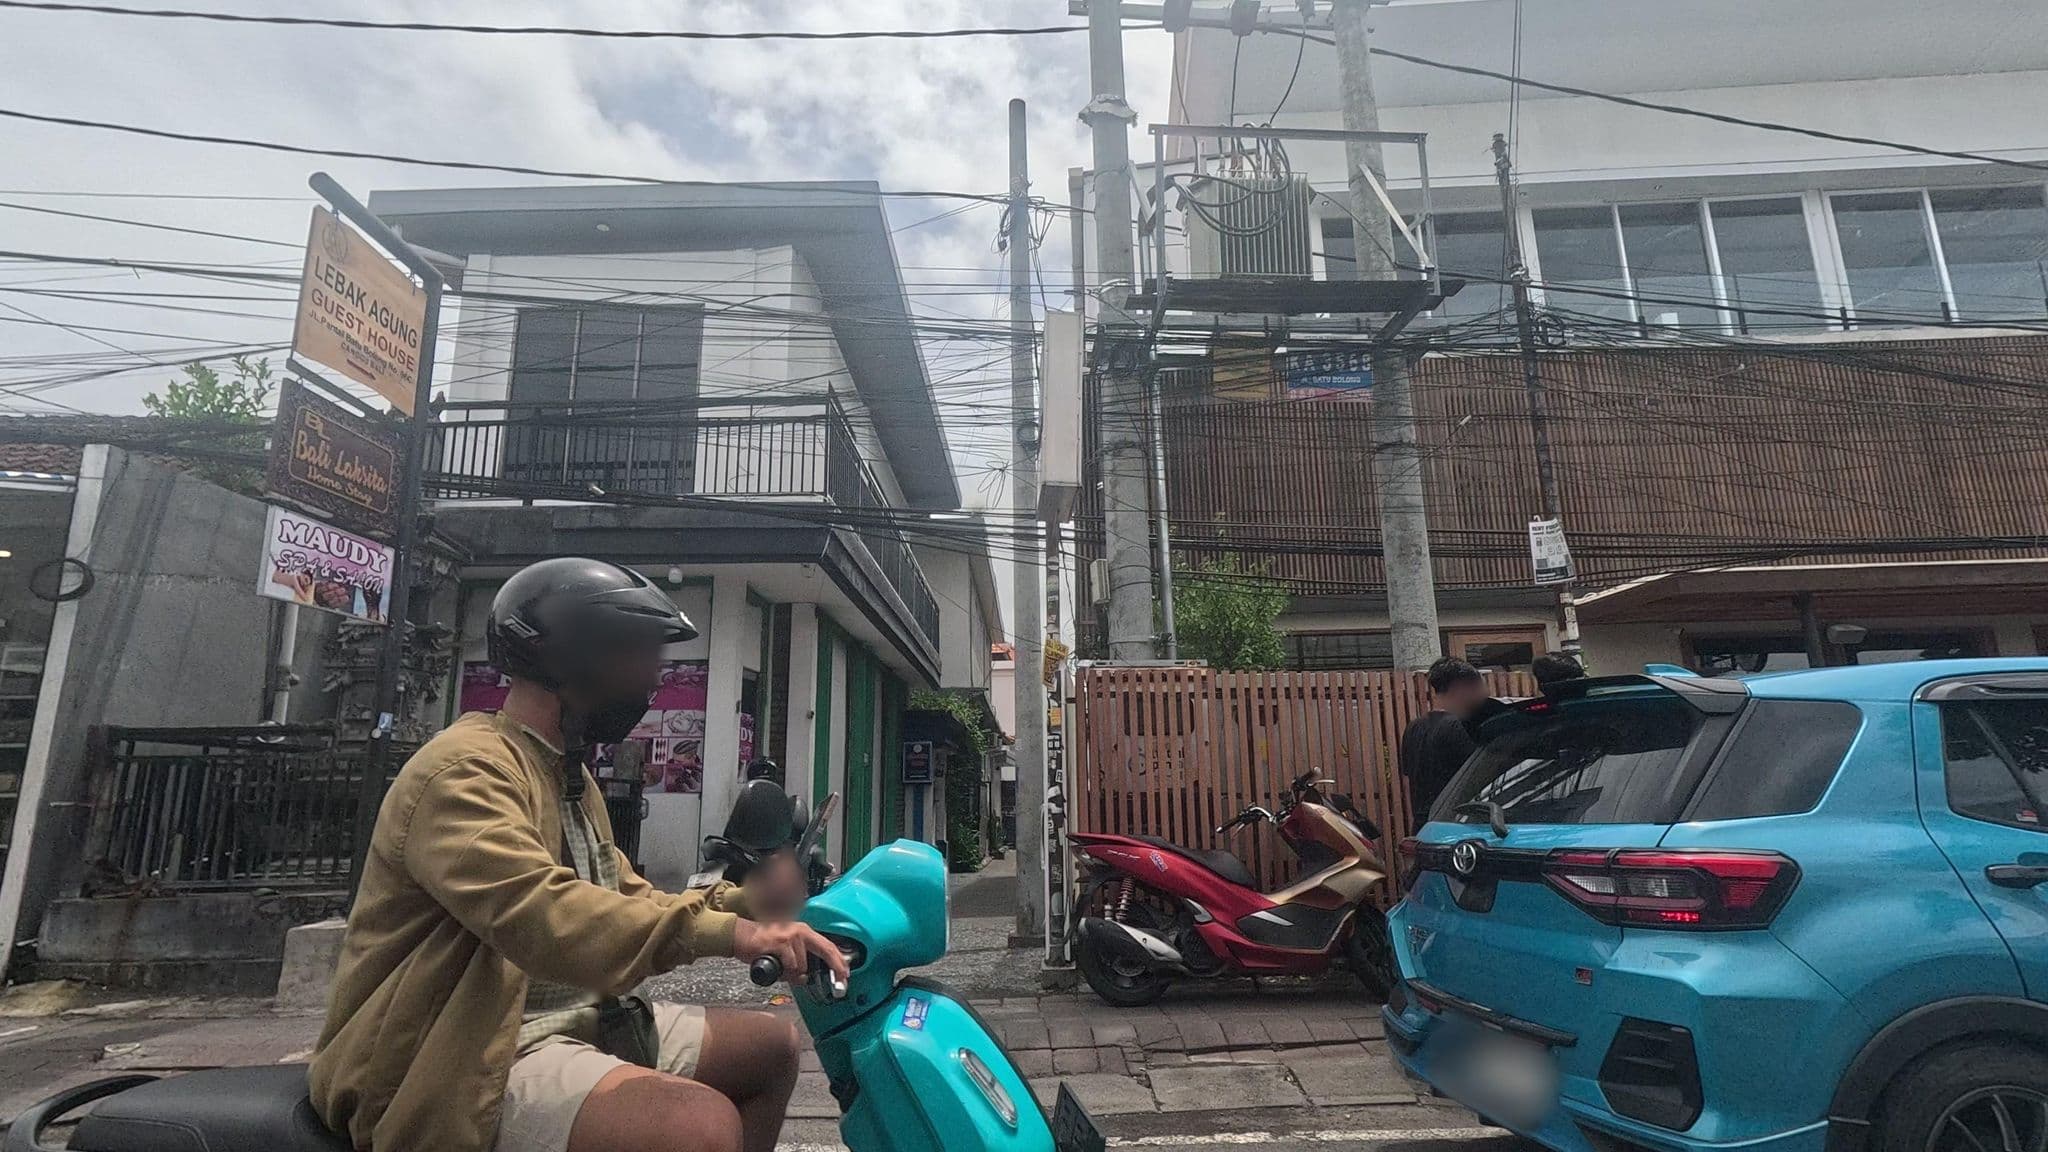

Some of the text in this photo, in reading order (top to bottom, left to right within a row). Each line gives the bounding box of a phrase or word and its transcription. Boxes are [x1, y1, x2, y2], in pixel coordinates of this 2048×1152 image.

[315, 255, 418, 349] LEBAK AGUNG
[311, 288, 416, 372] GUEST HOUSE
[295, 429, 332, 469] Bali
[307, 464, 373, 507] Home Stay
[277, 549, 321, 576] SPA
[321, 560, 333, 577] &
[278, 519, 388, 573] MAUDY
